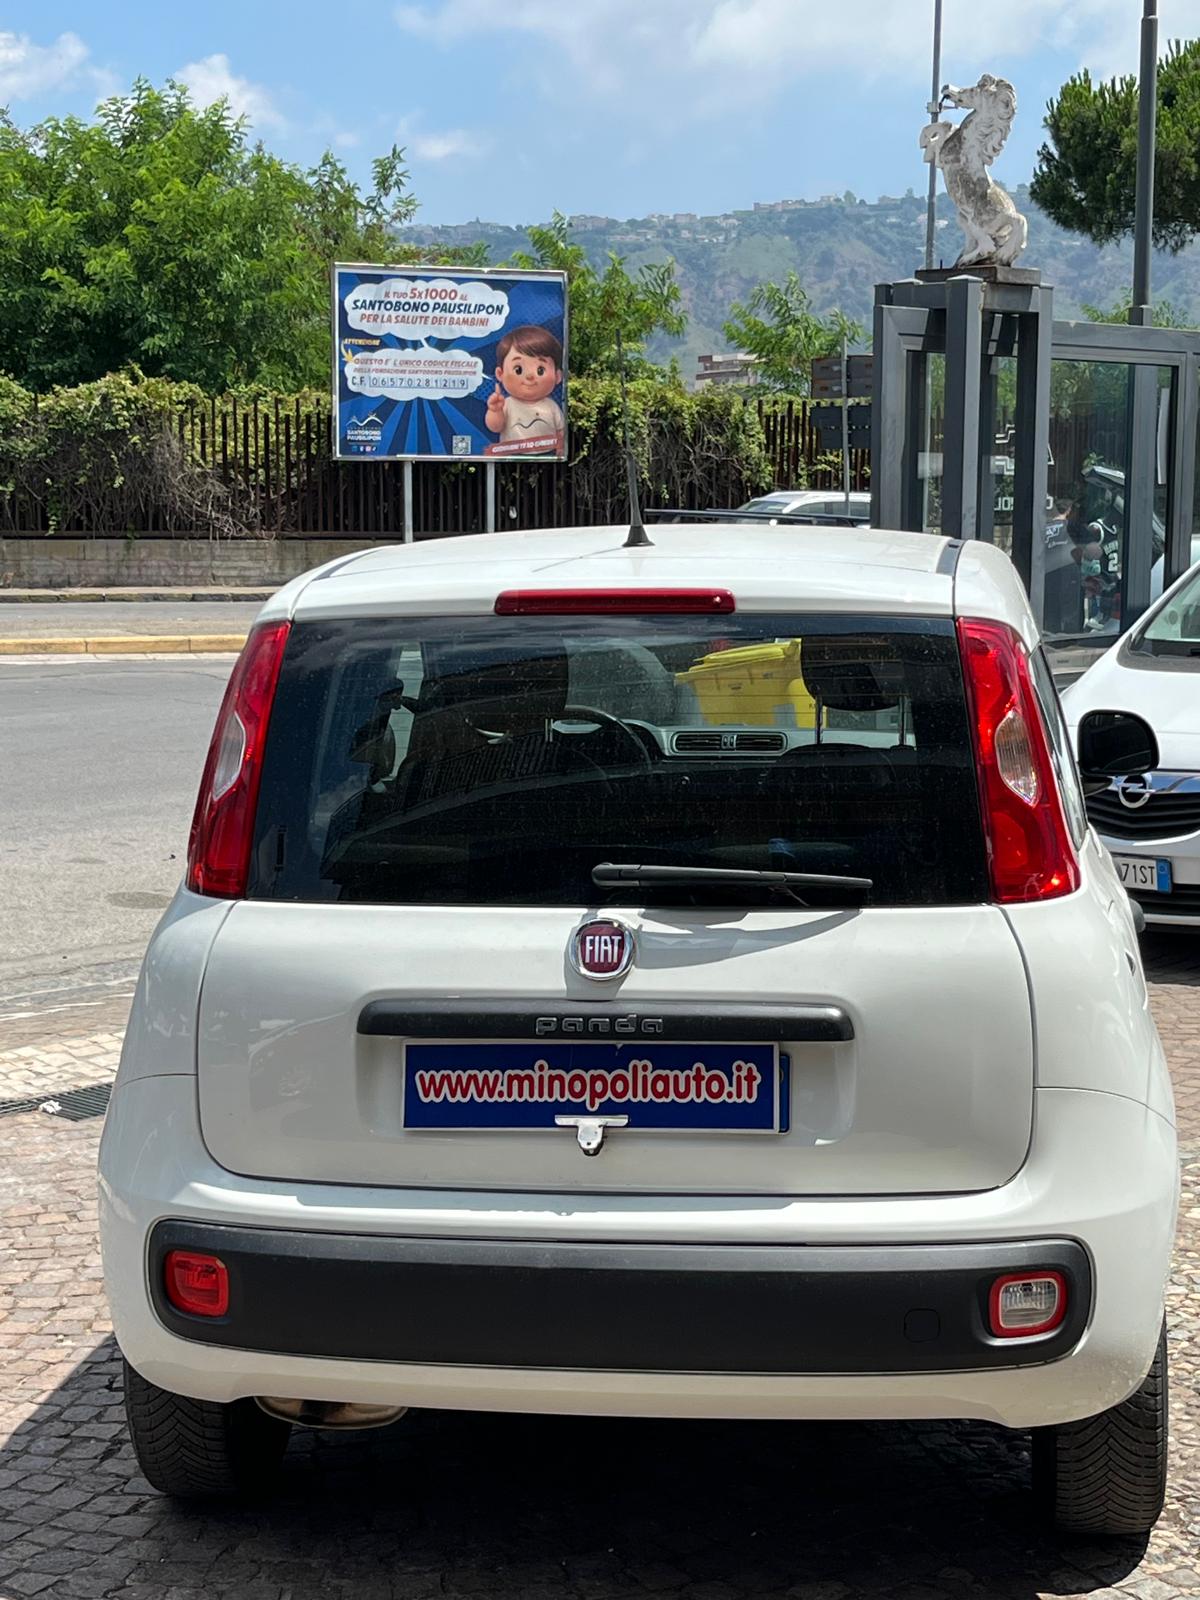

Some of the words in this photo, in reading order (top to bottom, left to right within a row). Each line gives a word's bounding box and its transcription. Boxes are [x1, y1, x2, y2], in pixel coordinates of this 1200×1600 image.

[393, 291, 408, 299] TUO
[409, 288, 457, 300] 5x1000
[352, 299, 430, 313] SANTOBONO
[432, 303, 504, 316] PAUSILIPON
[360, 313, 378, 322] PER
[381, 314, 392, 323] LA
[394, 315, 430, 325] SALUTE
[431, 317, 447, 326] DEI
[448, 317, 489, 327] BAMBINI
[354, 358, 384, 366] QUESTO
[423, 360, 449, 368] CODICE
[449, 361, 478, 369] FISCALE
[1117, 863, 1155, 885] 71ST
[585, 935, 622, 963] FIAT
[535, 1013, 664, 1036] panda
[416, 1061, 761, 1110] www.minopoliauto.it
